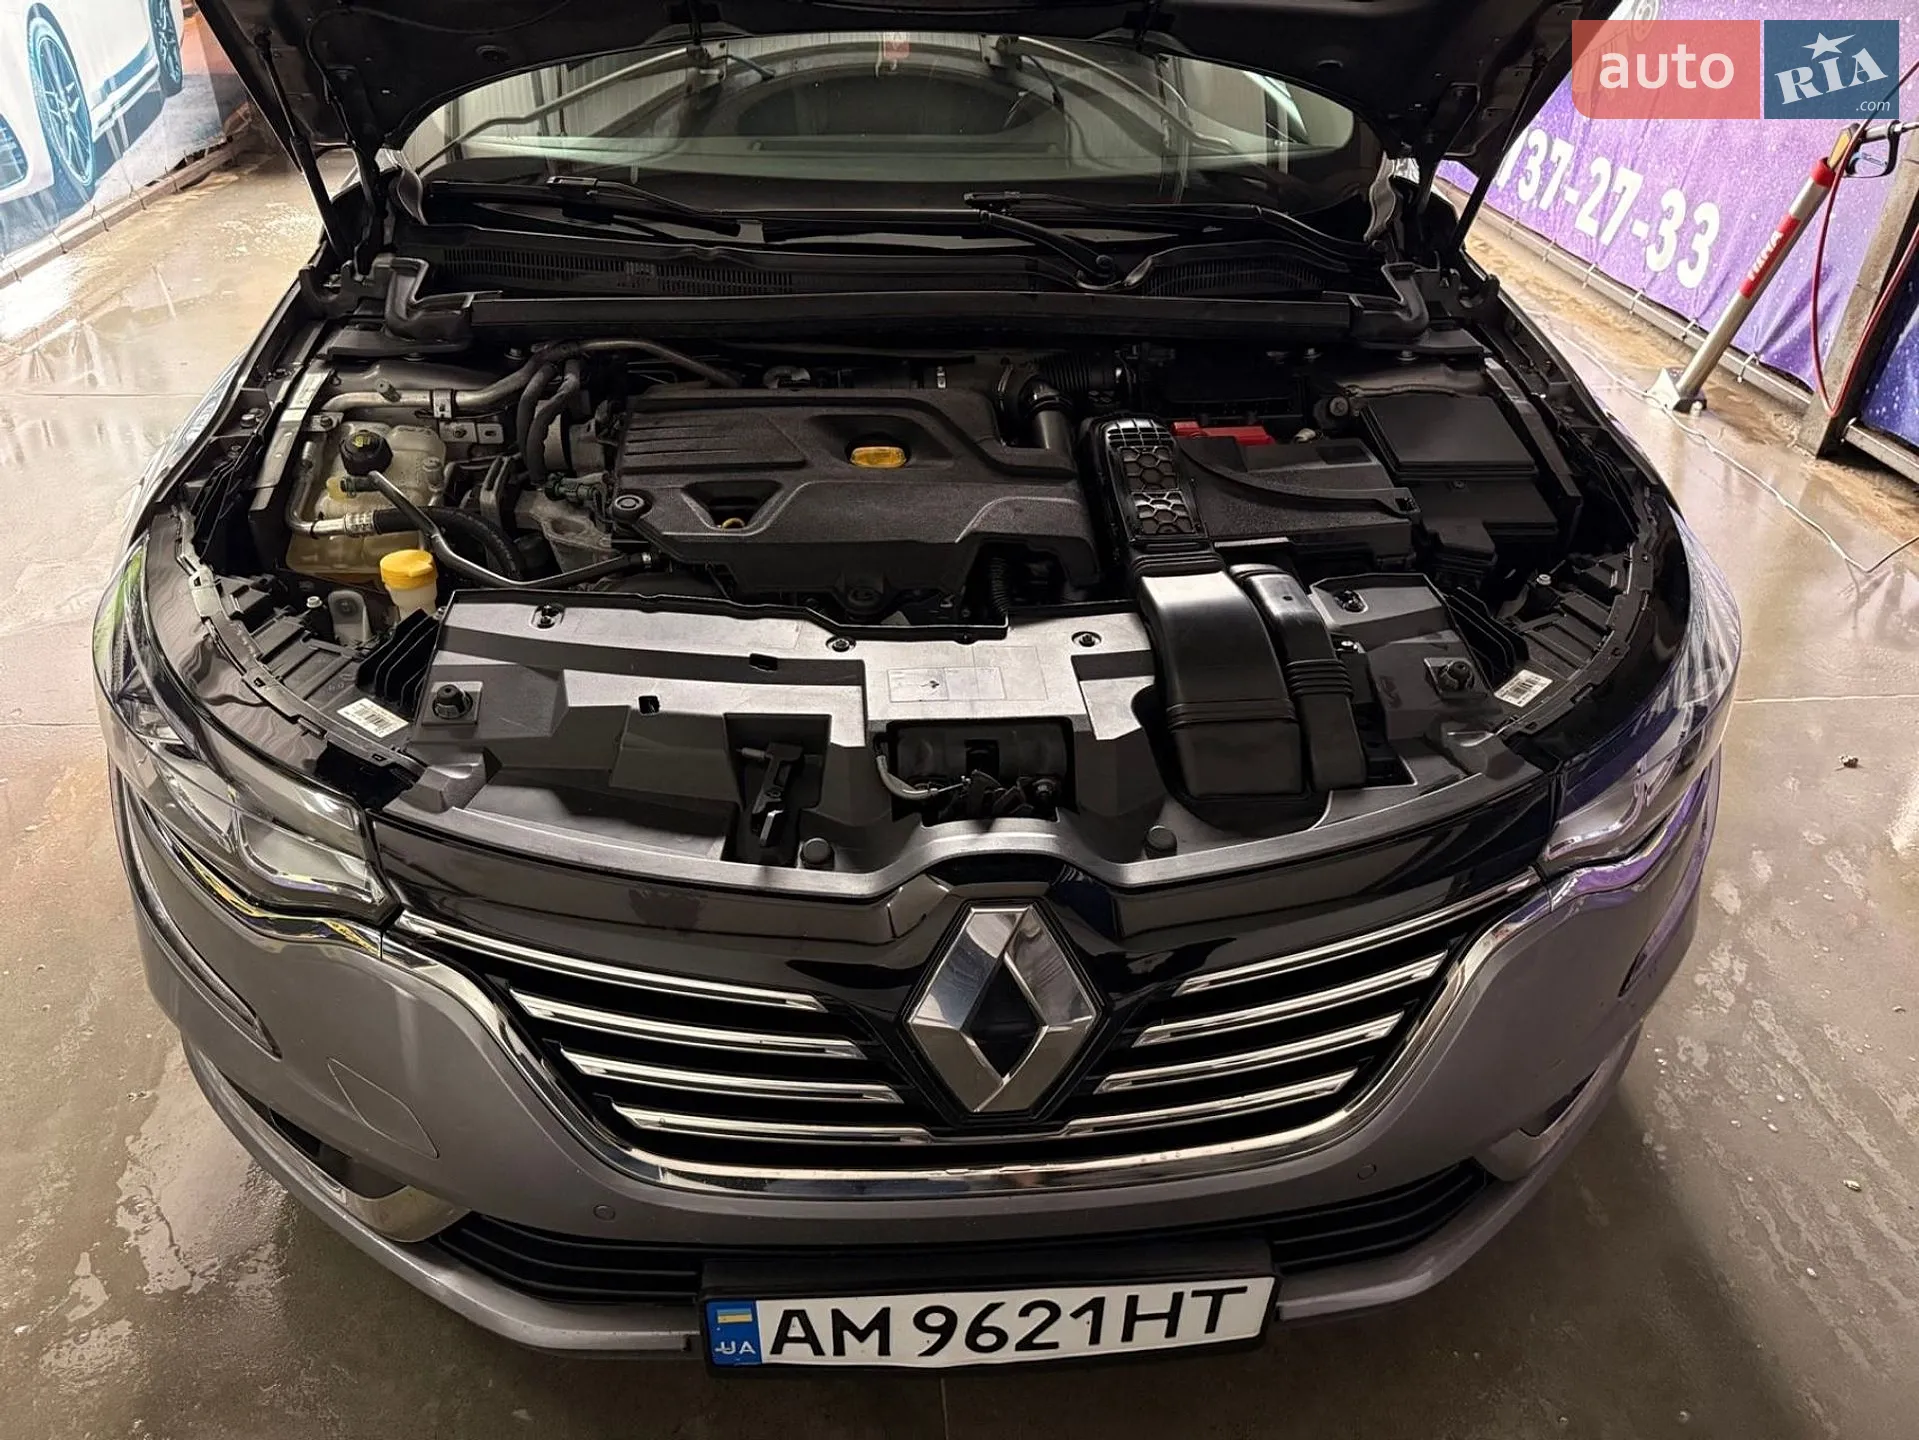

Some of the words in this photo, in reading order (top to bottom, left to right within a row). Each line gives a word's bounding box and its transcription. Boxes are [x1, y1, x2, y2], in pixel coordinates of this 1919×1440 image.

[769, 1307, 892, 1357] AM
[912, 1294, 1107, 1357] 9621
[1121, 1285, 1248, 1342] HT
[716, 1340, 756, 1355] UA
